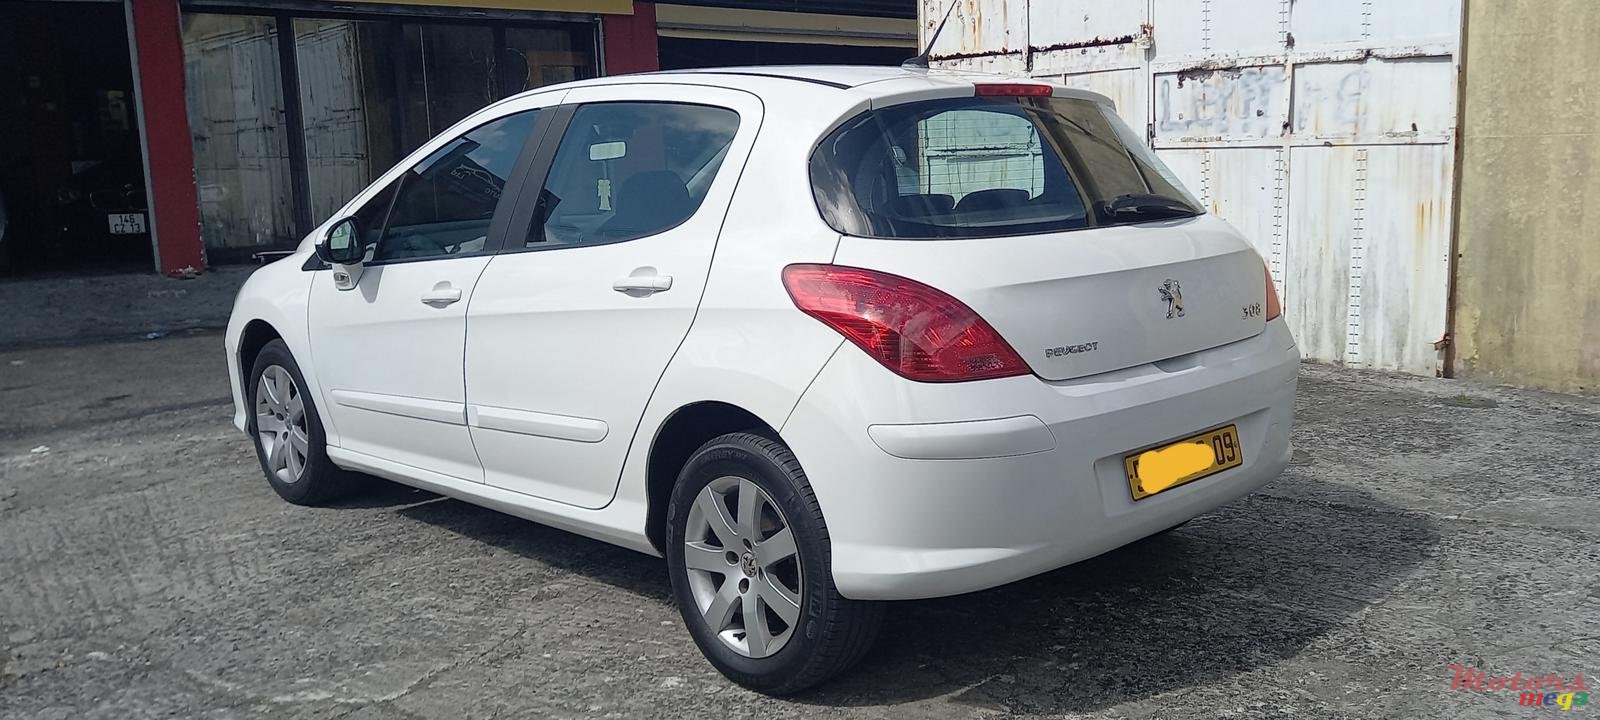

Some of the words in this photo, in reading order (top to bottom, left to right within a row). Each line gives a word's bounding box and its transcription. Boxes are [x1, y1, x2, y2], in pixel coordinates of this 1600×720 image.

[118, 214, 135, 223] 146
[114, 223, 126, 233] CZ
[130, 223, 141, 233] 13
[1045, 341, 1099, 358] PEUGEOT
[1212, 431, 1236, 466] 09
